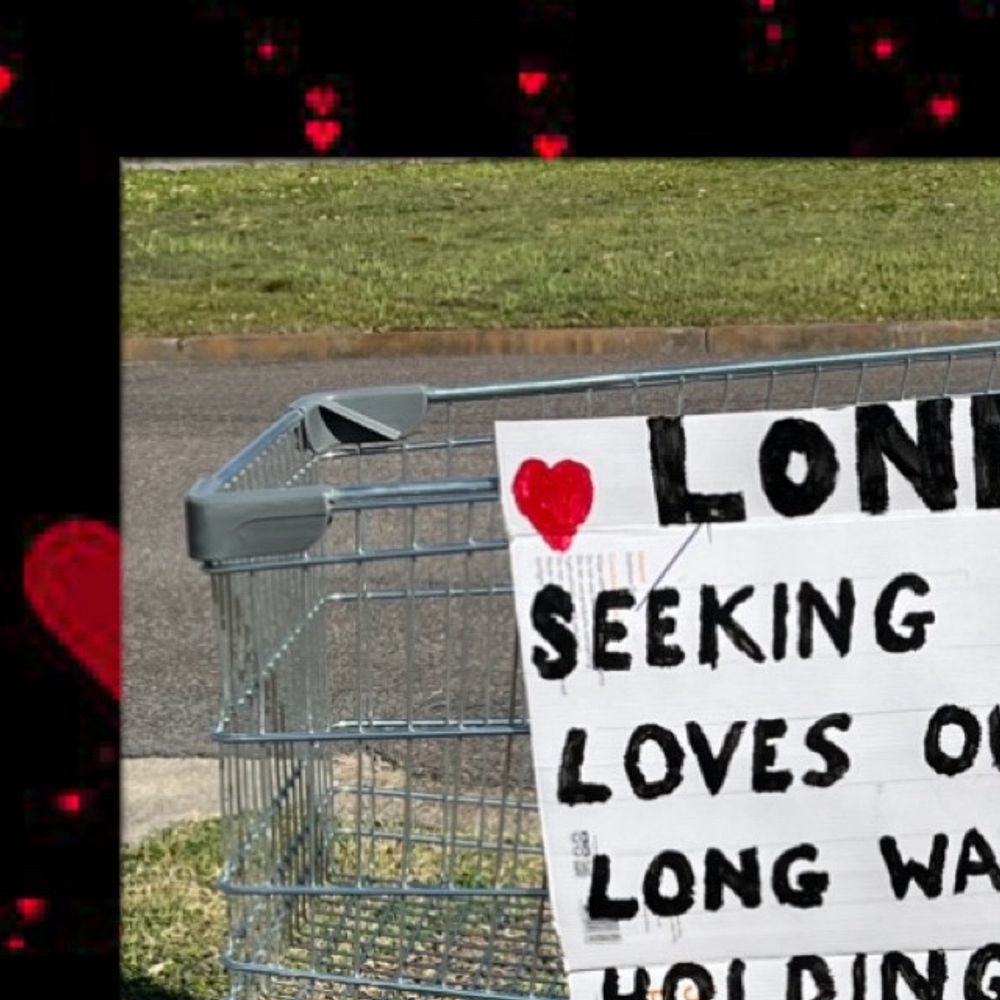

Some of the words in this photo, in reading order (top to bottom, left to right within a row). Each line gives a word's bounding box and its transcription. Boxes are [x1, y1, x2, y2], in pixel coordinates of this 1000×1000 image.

[531, 573, 935, 680] SEEKING
[558, 712, 851, 806] LOVES
[586, 843, 829, 922] LONG
